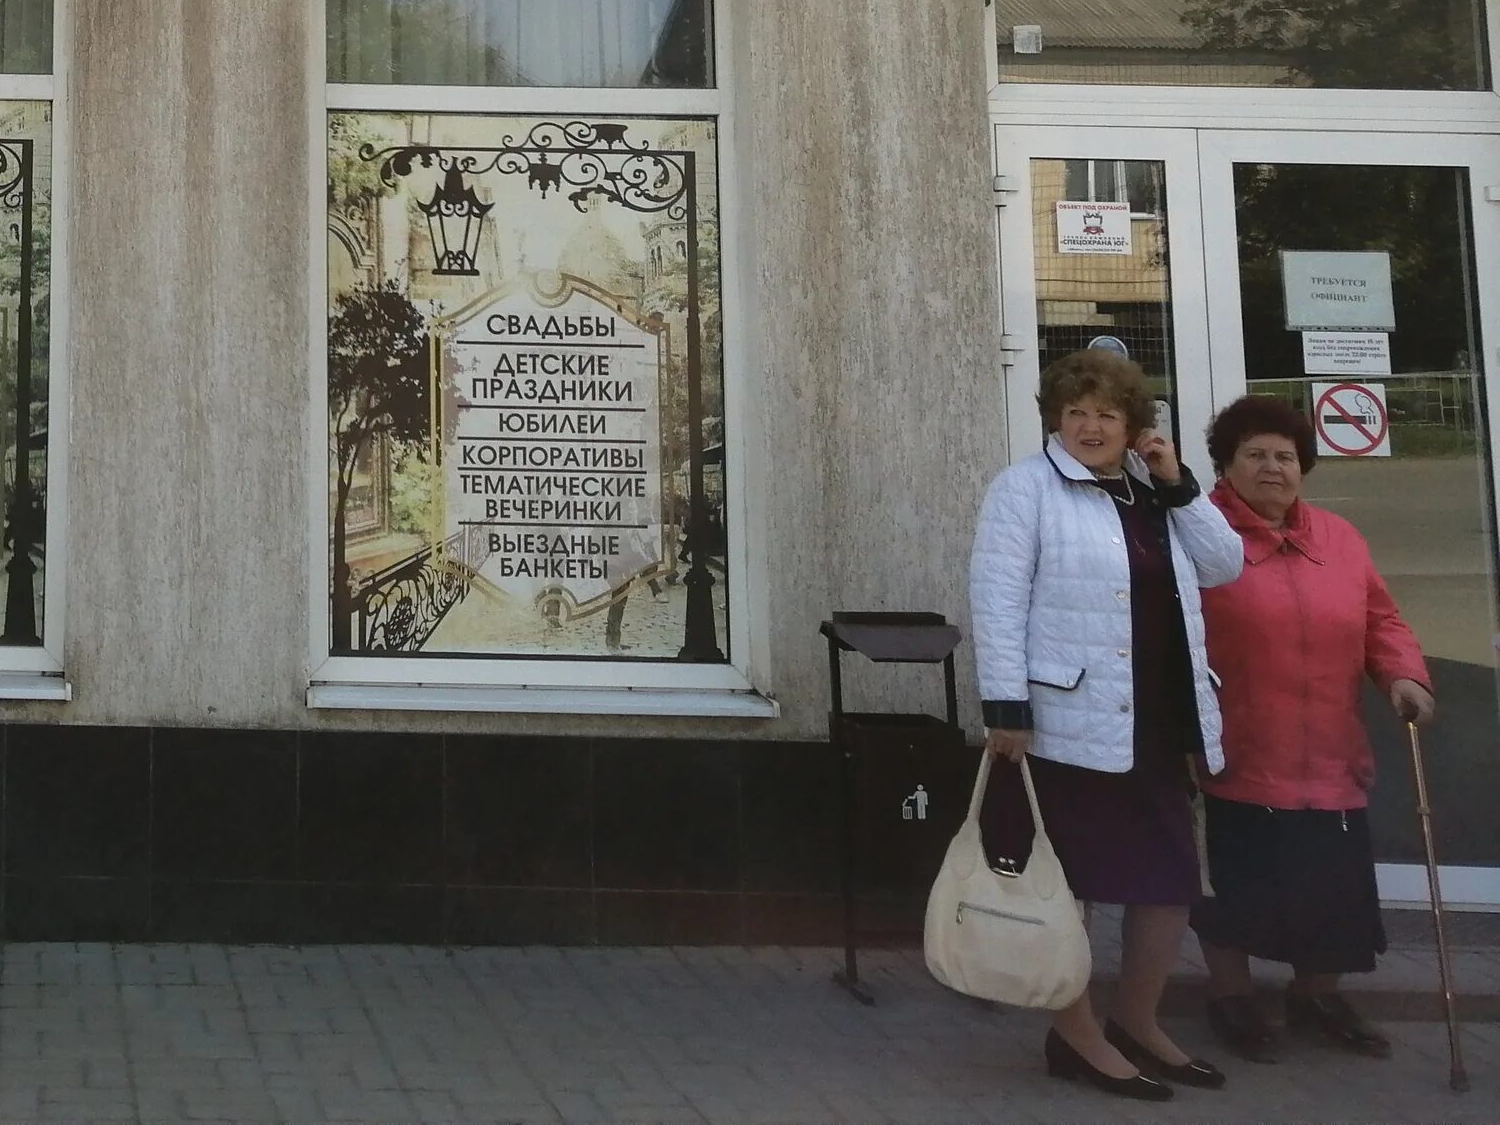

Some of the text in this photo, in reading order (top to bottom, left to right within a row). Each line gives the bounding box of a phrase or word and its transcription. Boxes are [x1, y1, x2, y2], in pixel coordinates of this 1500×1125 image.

[1311, 277, 1366, 287] ТРЕБУЕТСЯ
[1311, 293, 1368, 302] ОФИЦИАНТ
[487, 314, 615, 339] СВАДЬБЫ
[493, 354, 609, 377] ДЕТСКИЕ
[472, 378, 633, 403] ПРАЗДНИКИ
[499, 413, 606, 434] ЮБИЛЕИ
[462, 446, 643, 468] КОРПОРАТИВЫ
[460, 475, 645, 497] ТЕМАТИЧЕСКИЕ
[486, 500, 622, 521] ВЕЧЕРИНКИ
[489, 533, 620, 557] ВЫЕЗДНЫЕ
[500, 558, 608, 579] БАНКЕТЫ
